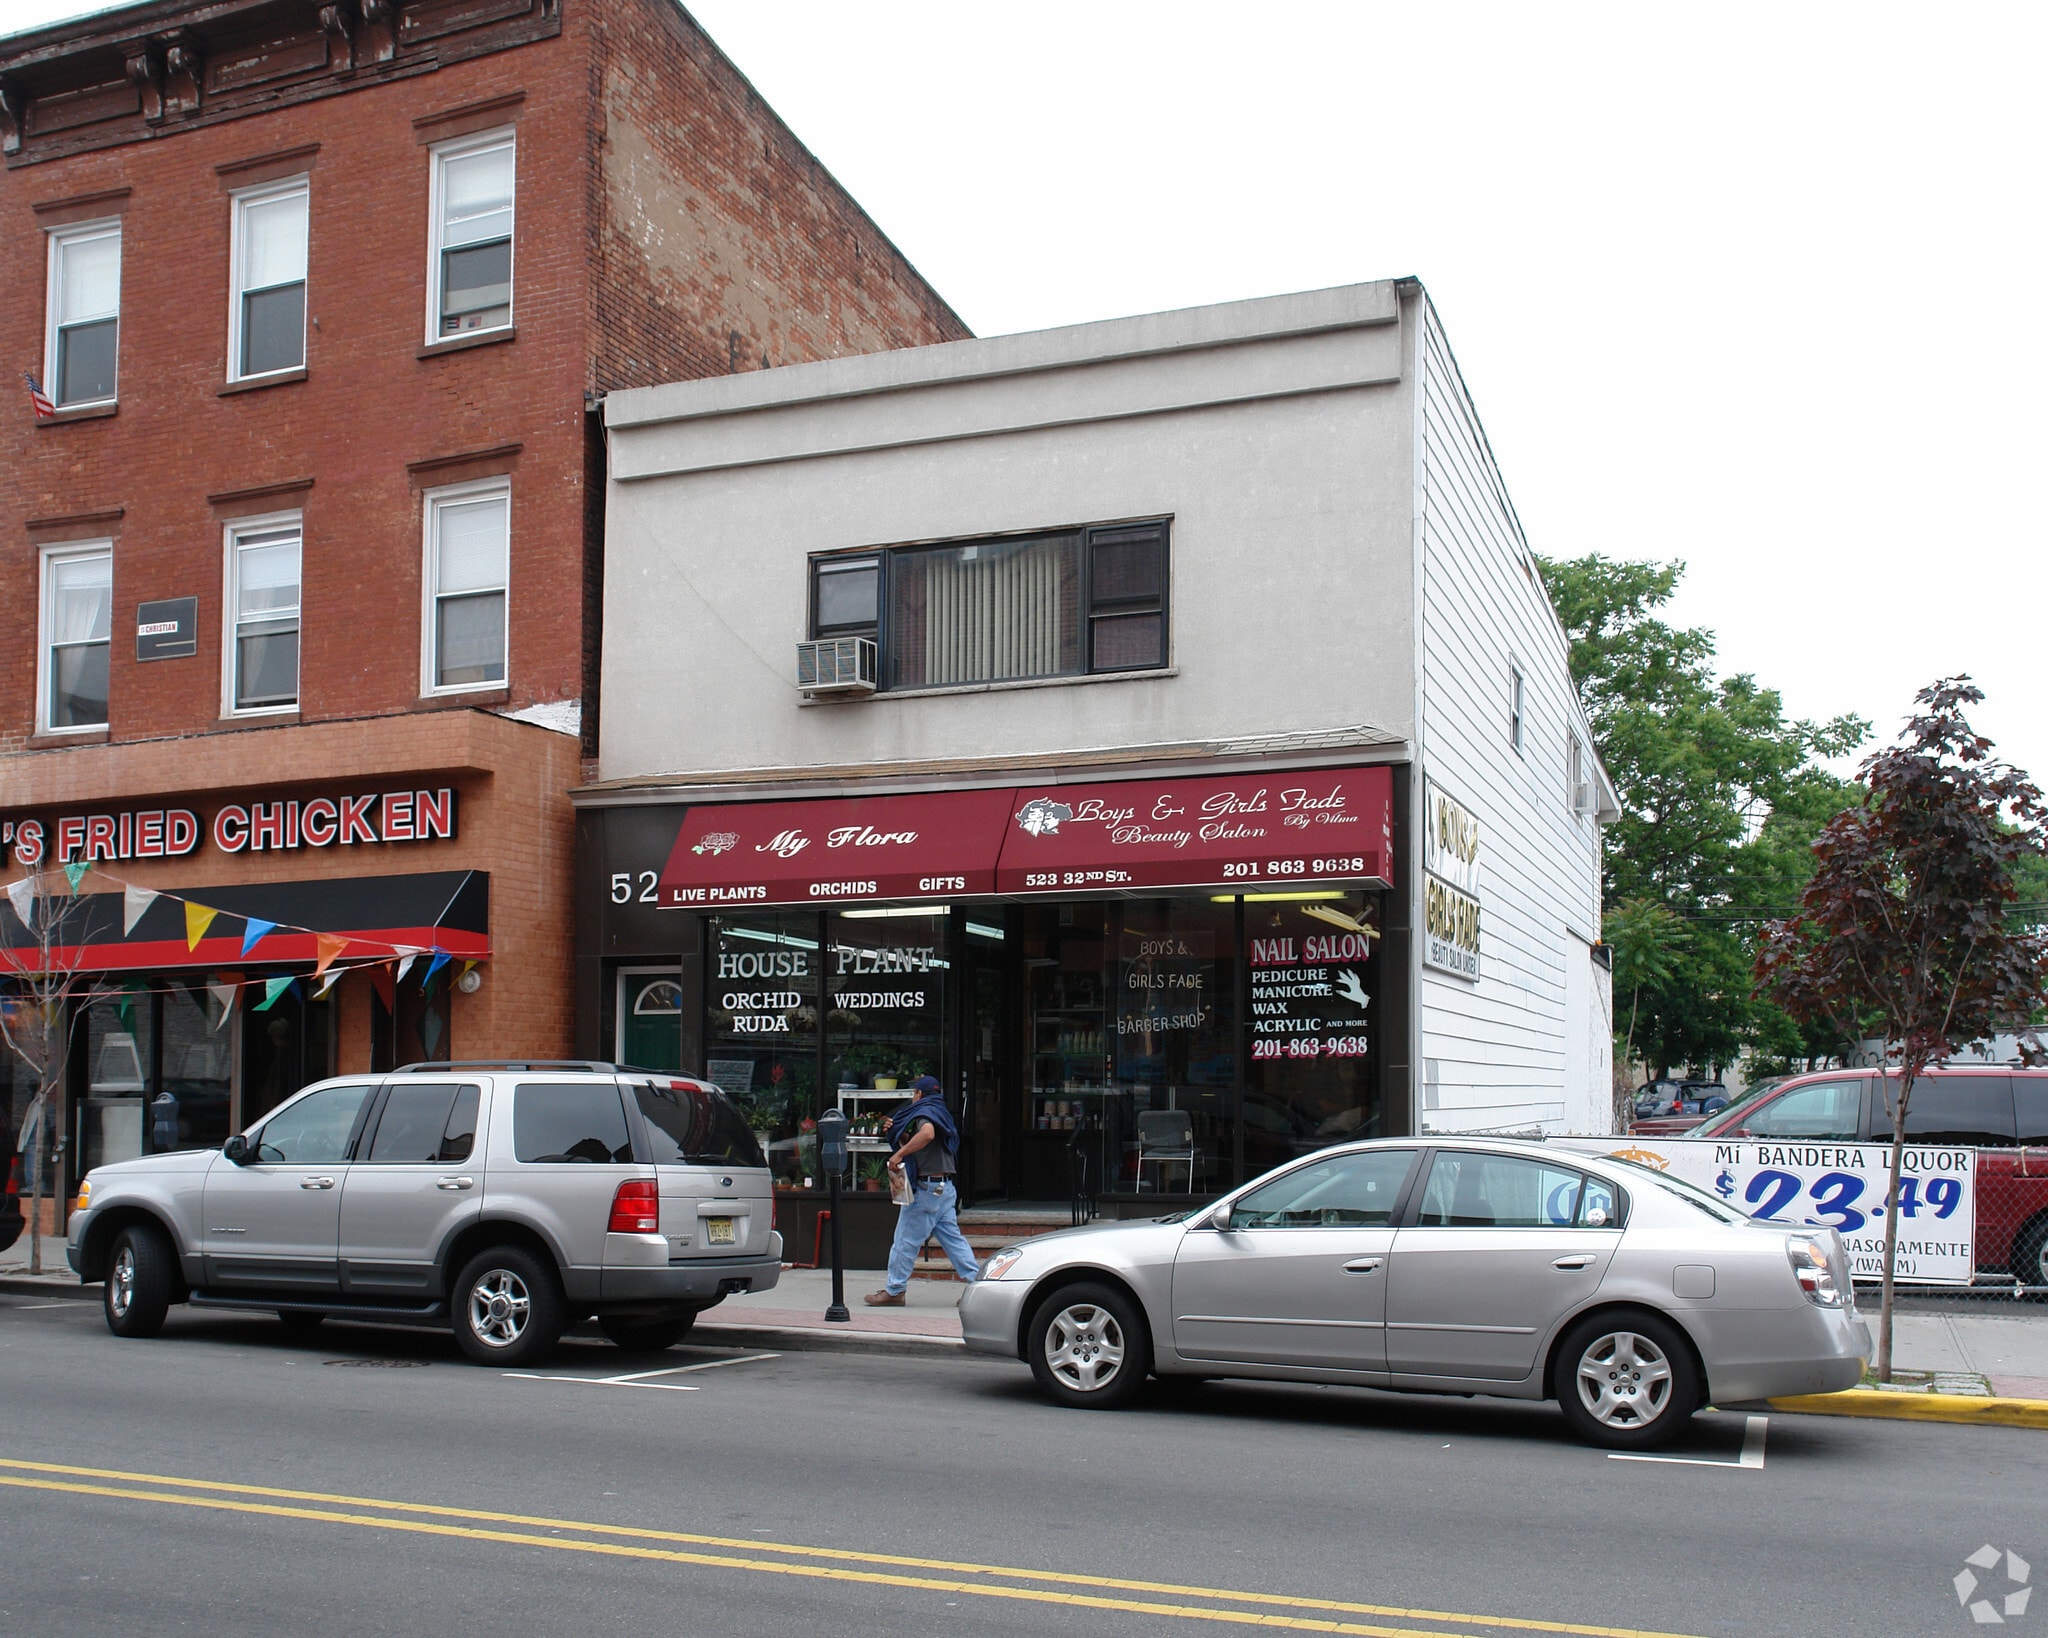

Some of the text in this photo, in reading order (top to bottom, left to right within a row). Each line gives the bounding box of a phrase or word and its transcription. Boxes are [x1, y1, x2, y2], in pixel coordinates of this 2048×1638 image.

[145, 622, 176, 634] CHRISTIAN
[1069, 784, 1346, 831] Boys & Girls Fade
[58, 808, 199, 863] FRIED
[213, 788, 453, 852] CHICKEN
[1283, 809, 1360, 830] By Vilma
[1438, 795, 1469, 863] BOYS
[755, 824, 919, 859] My Flora
[1111, 822, 1268, 849] Beauty Salon
[1222, 857, 1365, 878] 201 863 9638
[673, 876, 966, 902] LIVE PLANTS ORCHIDS GIFTS
[1025, 872, 1058, 887] 523
[1425, 877, 1481, 953] GIRLS FADE
[1140, 940, 1174, 956] BOYS
[1250, 933, 1371, 967] NAIL SALON
[717, 946, 934, 979] HOUSE PLANT
[1128, 973, 1204, 990] GIRLS FADE
[1251, 968, 1329, 983] PEDICURE
[722, 991, 925, 1011] ORCHID WEDDINGS
[1251, 984, 1334, 999] MANICURE
[1252, 1002, 1289, 1015] WAX
[732, 1015, 789, 1033] RUDA
[1117, 1013, 1206, 1035] BARBER SHOP
[1252, 1017, 1368, 1033] ACRYLIC AND MORE
[1251, 1036, 1369, 1060] 201-863-9638
[1757, 1147, 1865, 1168] BANDERA
[1882, 1151, 1968, 1172] LQUOR
[1856, 1258, 1917, 1275] (WAM)
